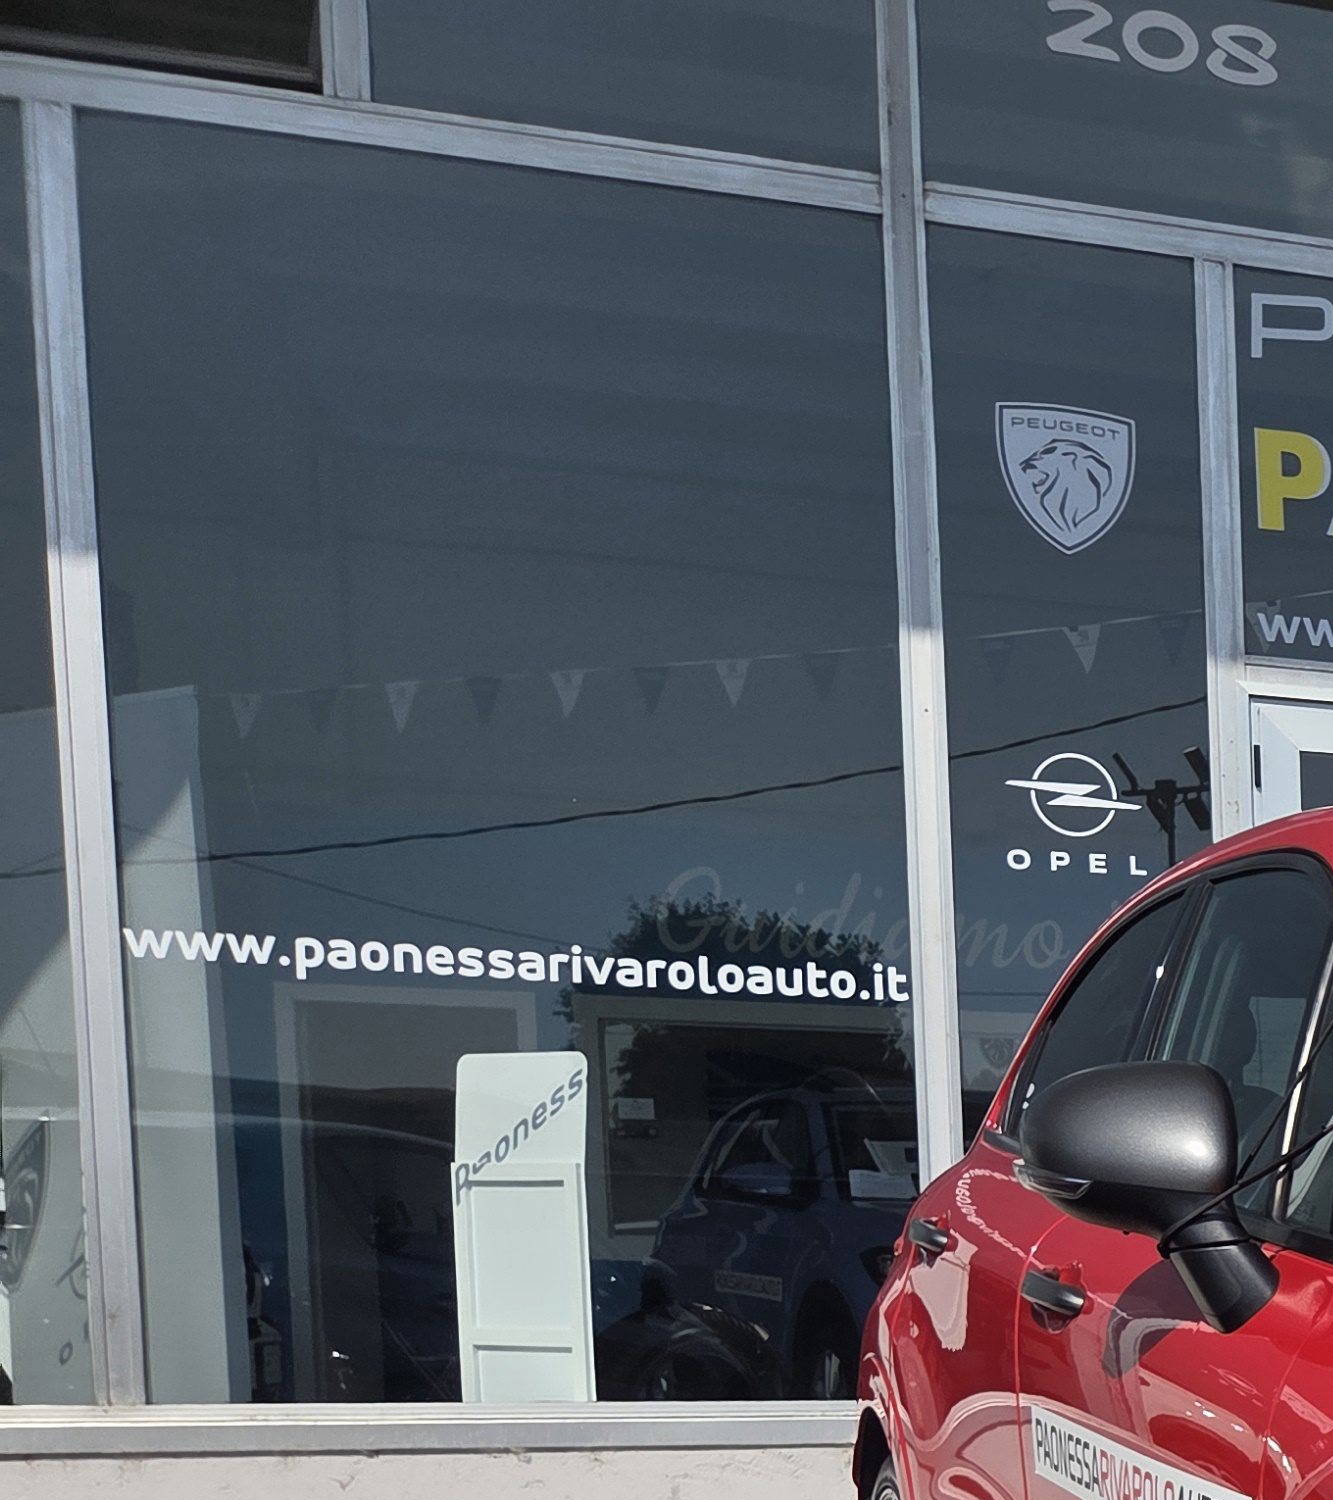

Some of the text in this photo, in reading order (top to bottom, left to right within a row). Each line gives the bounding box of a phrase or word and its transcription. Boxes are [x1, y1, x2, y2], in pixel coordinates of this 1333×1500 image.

[1045, 0, 1278, 86] 208
[1011, 416, 1121, 440] PEUGEOT
[1006, 849, 1147, 876] OPEL
[123, 926, 911, 1002] www.paonessarivaroloauto.it
